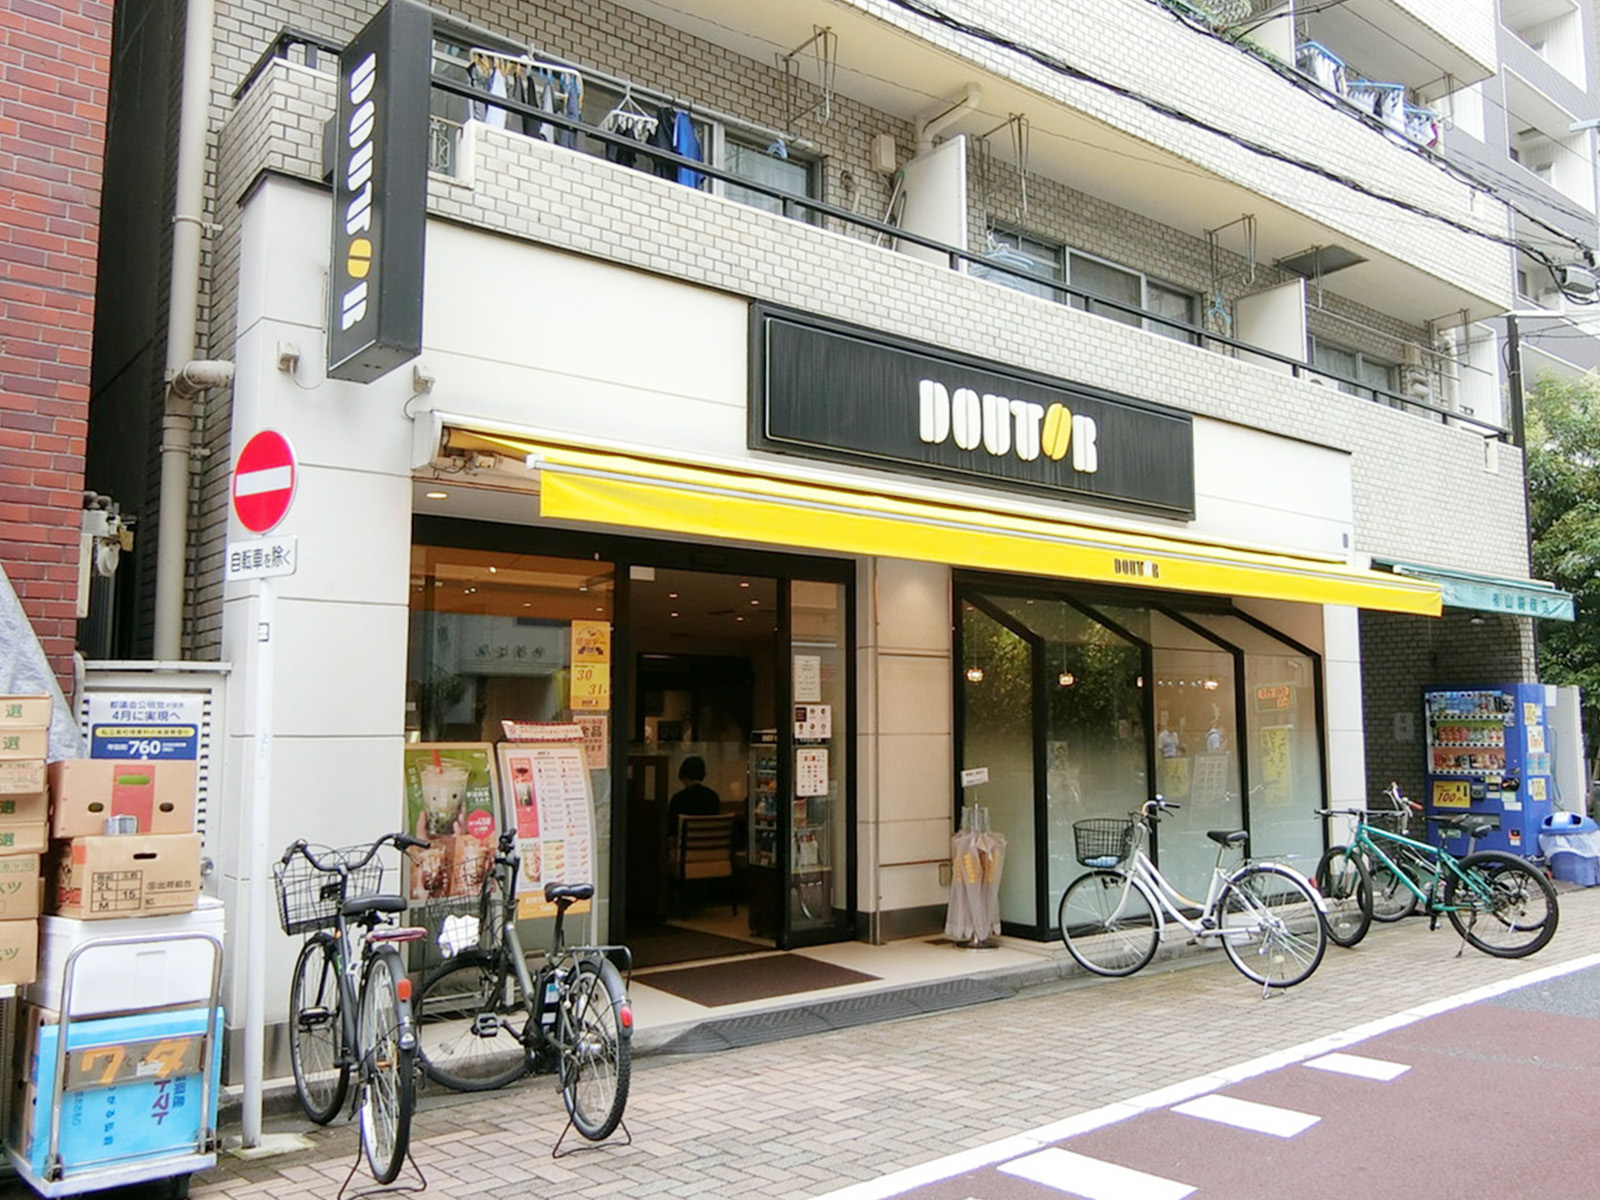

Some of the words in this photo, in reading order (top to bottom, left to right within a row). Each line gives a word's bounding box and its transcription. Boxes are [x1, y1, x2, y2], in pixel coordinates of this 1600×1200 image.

[340, 52, 377, 331] DOUTOR
[919, 379, 1098, 474] DOUTOR
[231, 545, 292, 573] 自転車を除く
[577, 669, 593, 681] 30
[128, 740, 162, 755] 760
[1437, 792, 1457, 803] 100
[97, 882, 112, 891] 2L
[123, 890, 136, 900] 15
